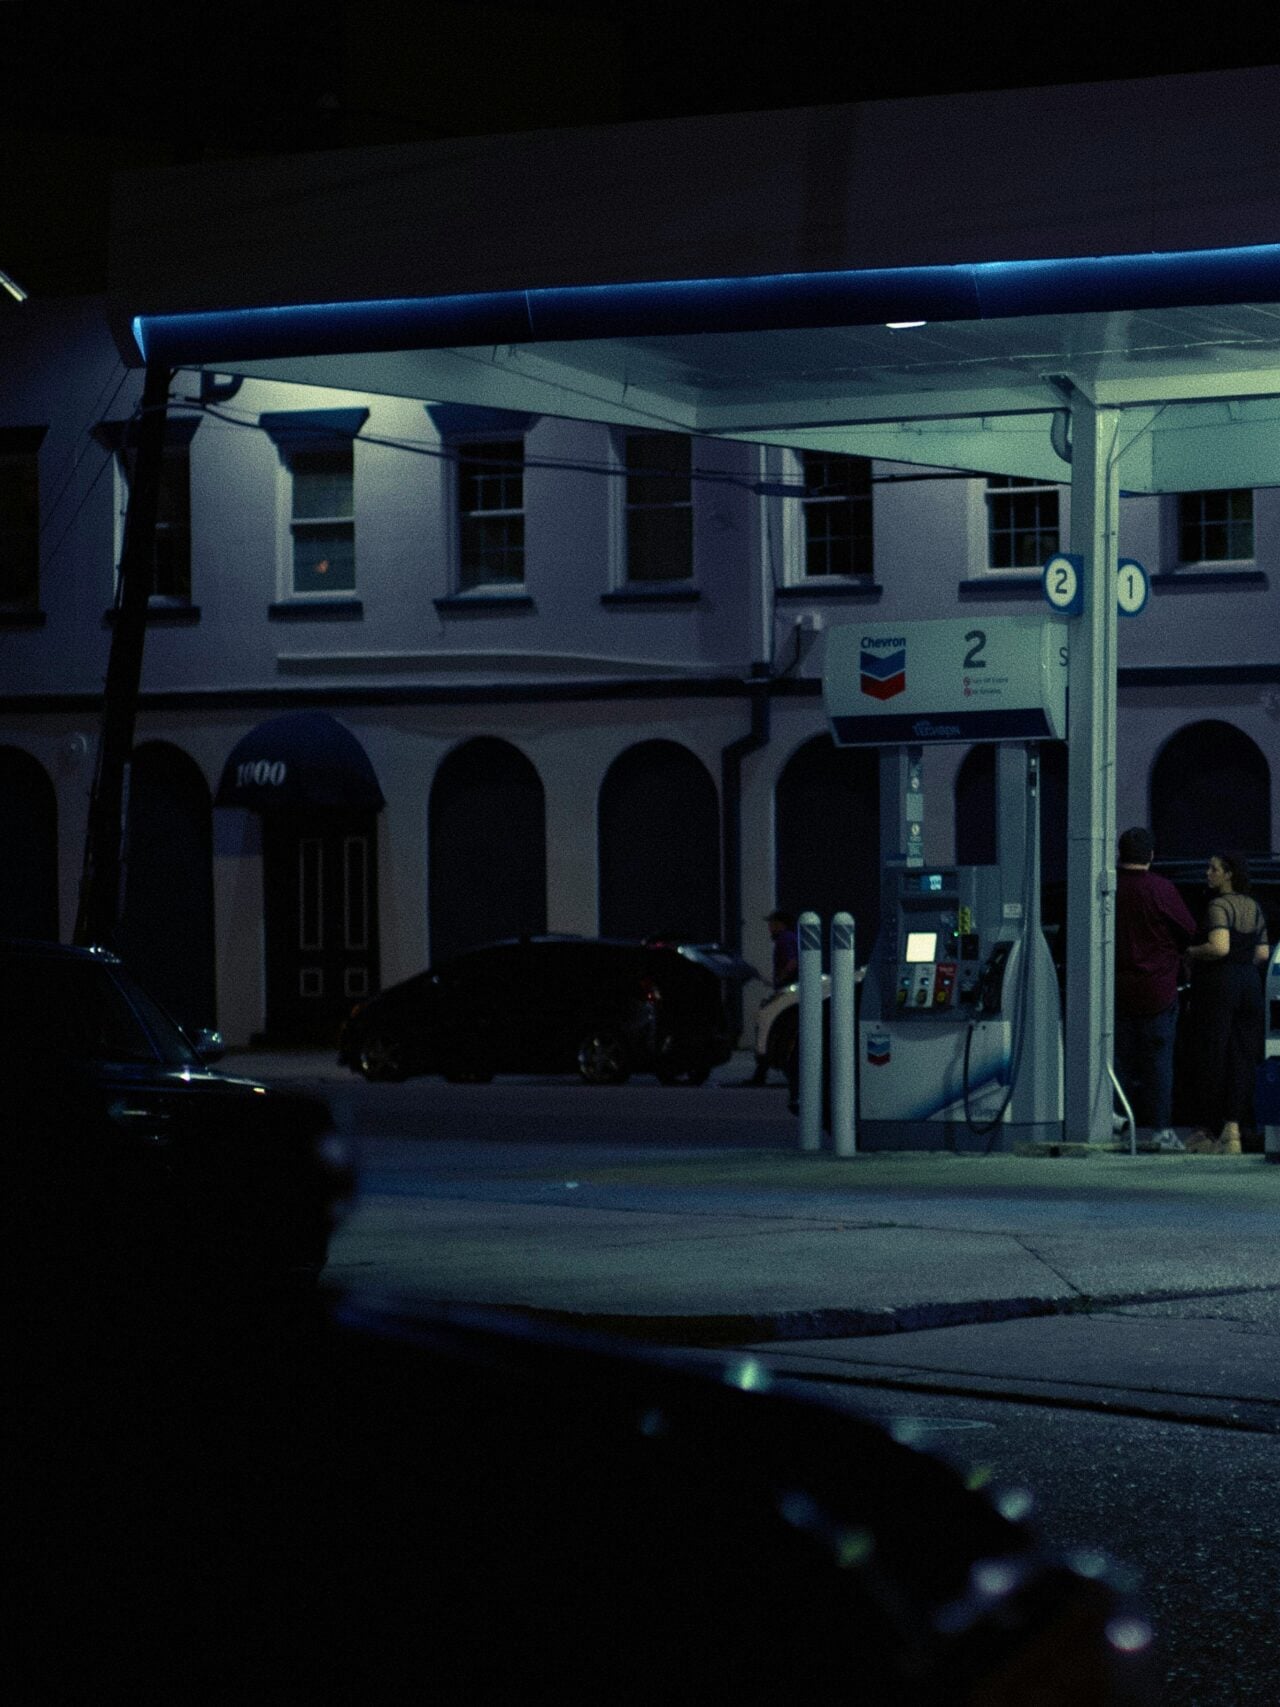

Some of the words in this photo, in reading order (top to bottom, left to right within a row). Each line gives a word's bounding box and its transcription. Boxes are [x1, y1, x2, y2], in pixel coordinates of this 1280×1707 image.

[1055, 568, 1068, 594] 2
[1127, 574, 1134, 599] 1
[861, 637, 906, 648] Chevron
[963, 630, 986, 668] 2
